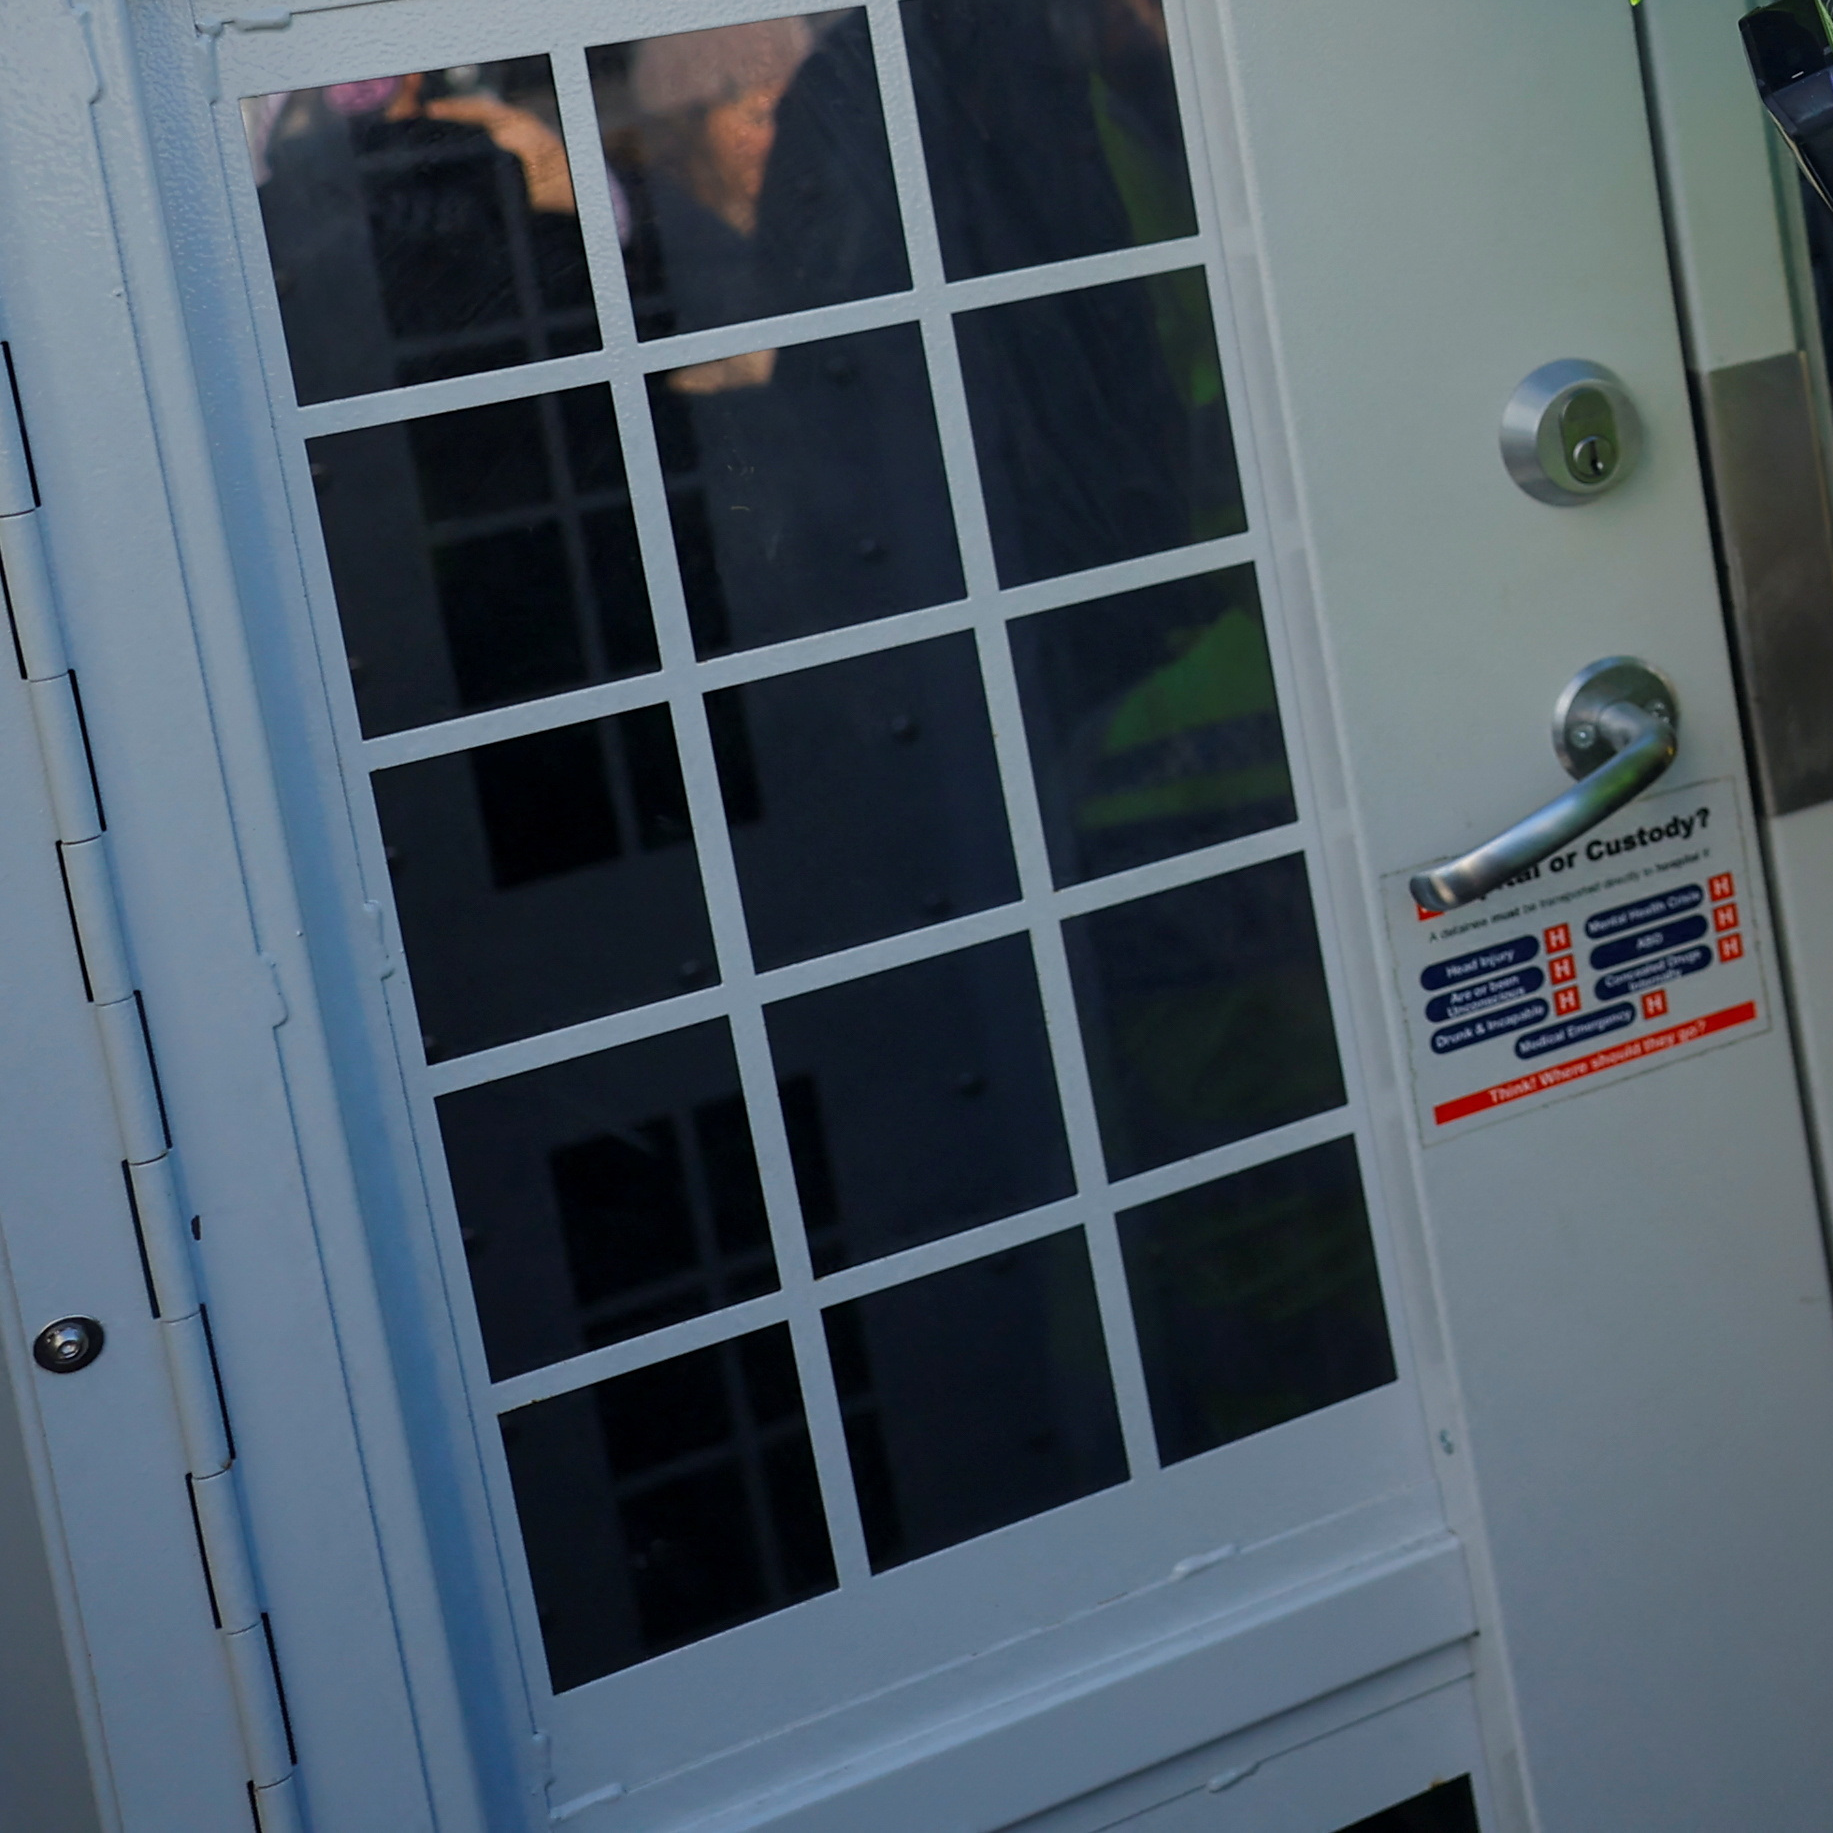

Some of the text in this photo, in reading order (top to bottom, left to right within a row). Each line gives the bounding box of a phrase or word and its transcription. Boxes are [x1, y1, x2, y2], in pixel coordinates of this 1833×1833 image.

[1549, 807, 1710, 873] or Custody?
[1518, 1029, 1567, 1054] Medical
[1567, 1007, 1632, 1039] Emergency
[1538, 1061, 1589, 1087] Where
